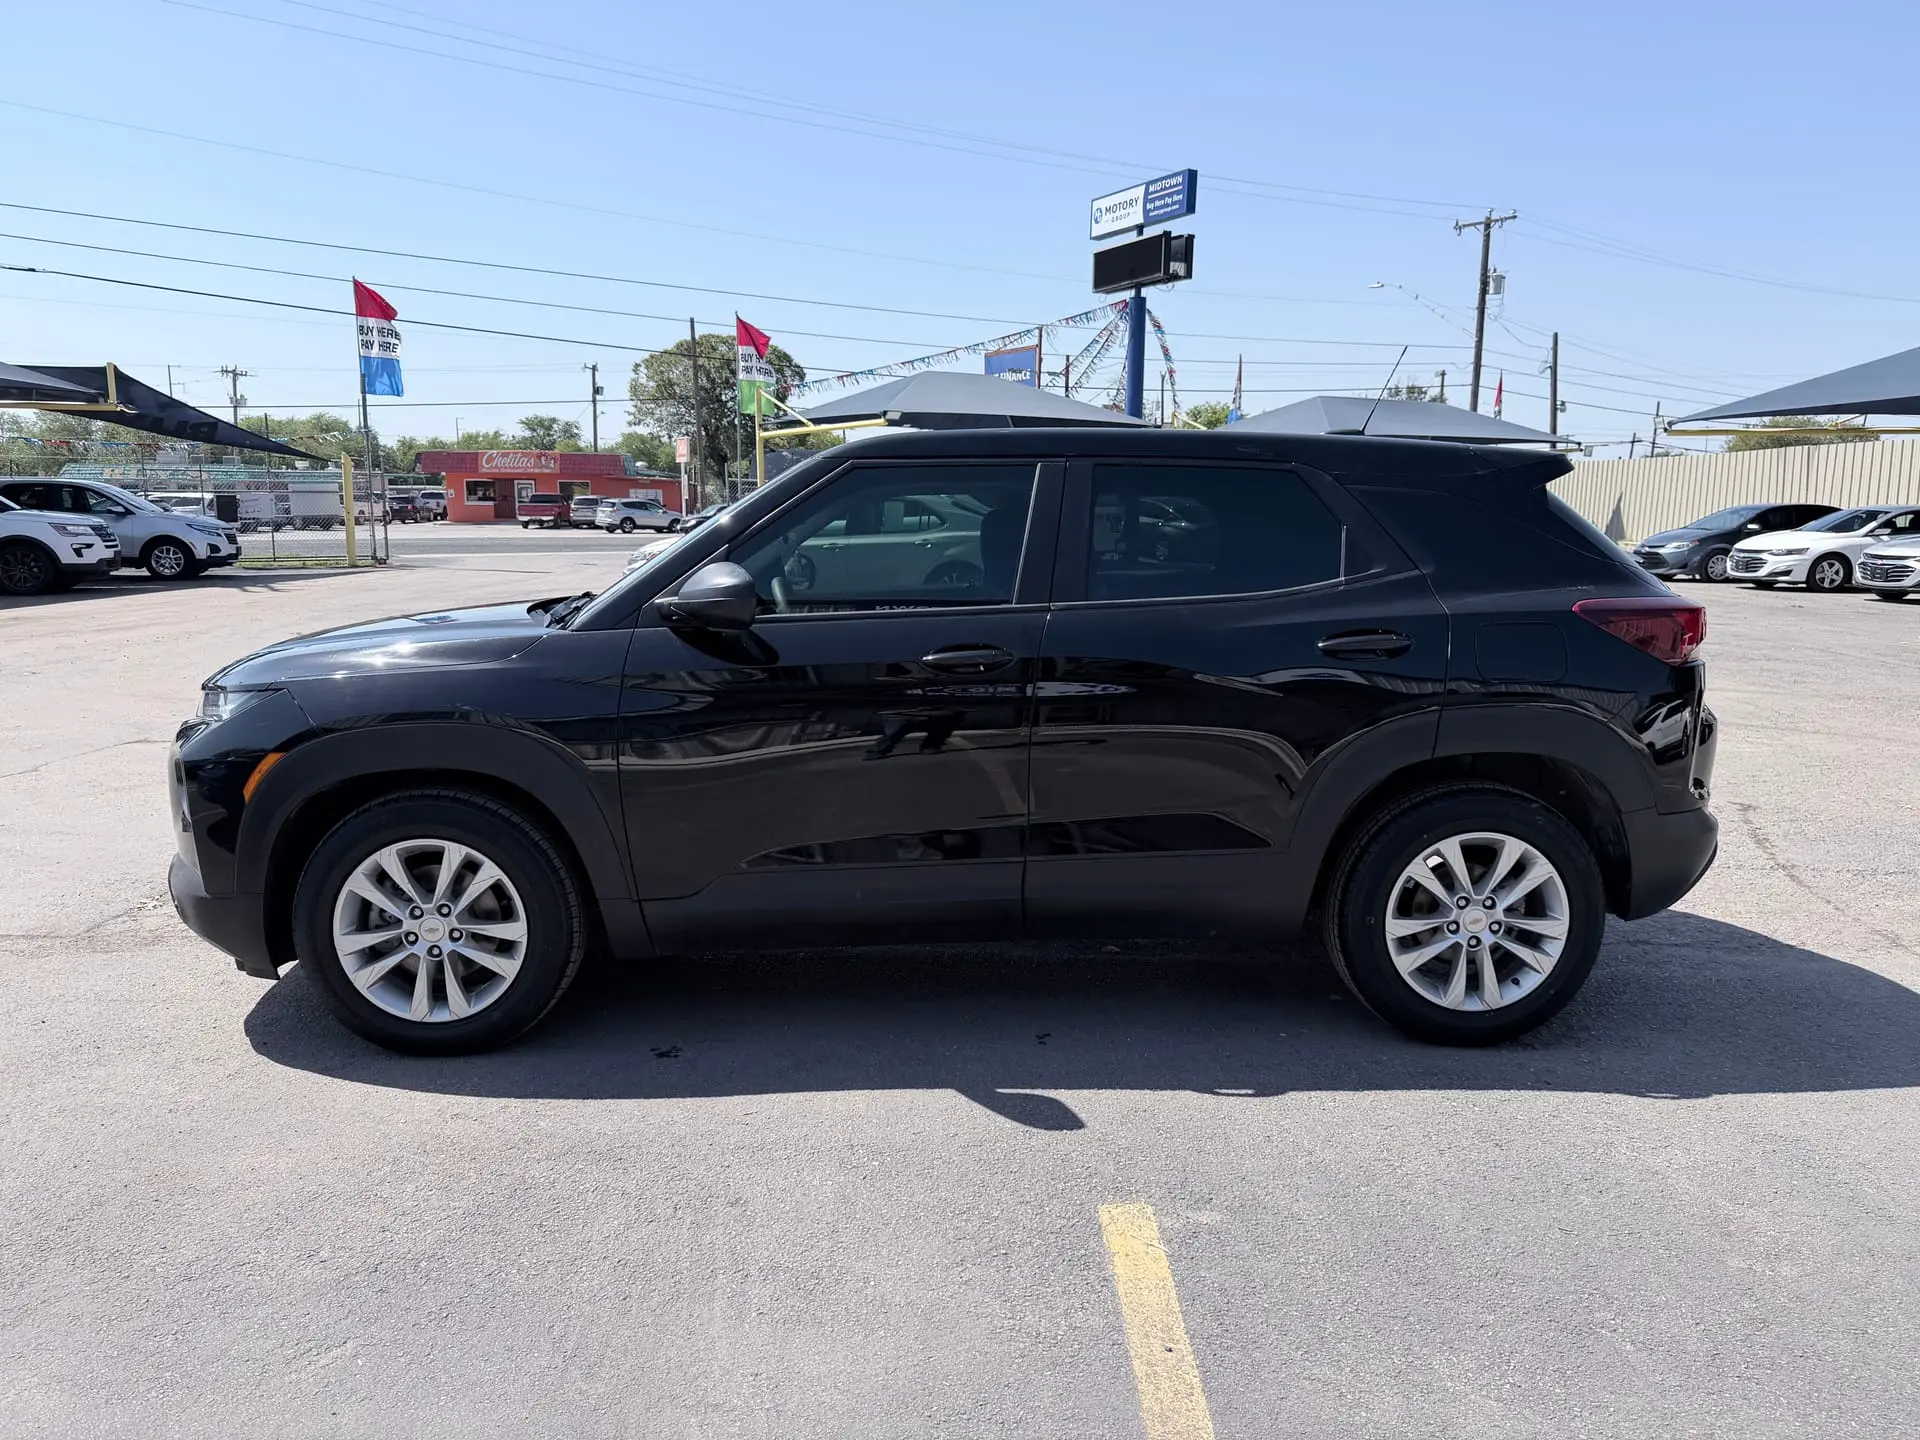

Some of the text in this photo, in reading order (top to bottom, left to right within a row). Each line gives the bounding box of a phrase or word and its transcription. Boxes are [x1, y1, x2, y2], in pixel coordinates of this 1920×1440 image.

[1148, 174, 1183, 193] MIDTOWN
[1104, 196, 1140, 216] MOTORY
[1146, 193, 1183, 210] Buy Here Pay Here
[1111, 211, 1131, 223] GROUP
[358, 324, 401, 341] BUY HERE
[360, 339, 399, 353] PAY HERE
[740, 353, 754, 363] BUY
[741, 365, 754, 375] PAY
[482, 450, 534, 468] Chelitas
